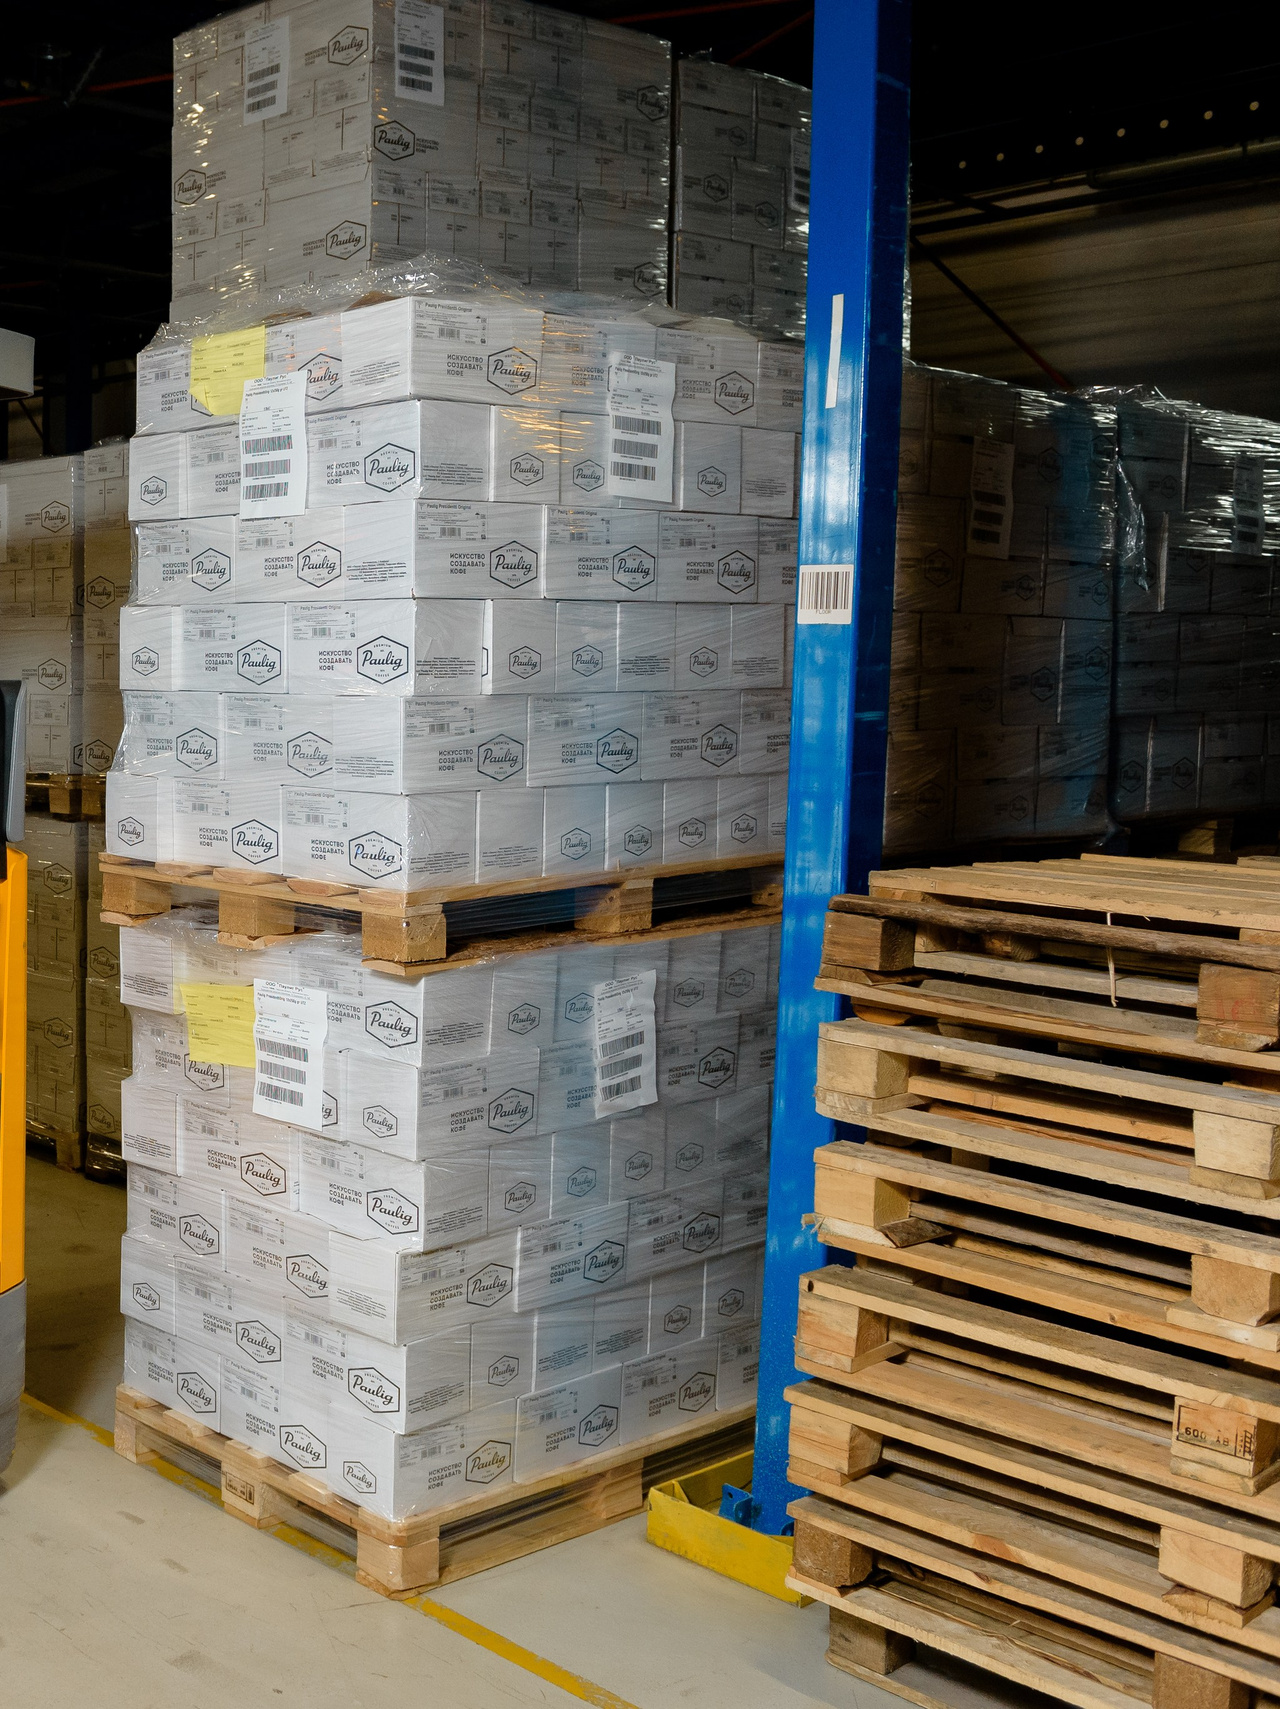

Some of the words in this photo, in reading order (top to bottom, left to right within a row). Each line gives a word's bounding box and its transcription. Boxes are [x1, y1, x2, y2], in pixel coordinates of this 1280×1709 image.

[332, 37, 364, 53] Paulig
[378, 132, 410, 149] Paulig
[177, 181, 203, 194] Paulig
[330, 234, 361, 249] Paulig
[447, 362, 483, 370] СОЗДАВАТЬ
[493, 360, 531, 383] Paulig
[718, 384, 749, 402] Paulig
[369, 459, 409, 477] Paulig
[513, 462, 541, 477] Paulig
[576, 470, 601, 482] Paulig
[700, 474, 724, 488] Paulig
[43, 511, 67, 523] Paulig
[196, 561, 226, 579] Paulig
[301, 556, 336, 574] Paulig
[495, 556, 533, 575] Paulig
[617, 561, 651, 578] Paulig
[722, 565, 751, 581] Paulig
[242, 654, 277, 672] Paulig
[361, 650, 403, 670] Paulig
[512, 657, 538, 670] Paulig
[574, 657, 599, 668] Paulig
[41, 669, 63, 681] Paulig
[180, 740, 213, 760] Paulig
[601, 742, 634, 760] Paulig
[705, 738, 733, 752] Paulig
[88, 749, 110, 762] Paulig
[292, 744, 328, 766] Paulig
[483, 748, 519, 768] Paulig
[236, 833, 273, 852] Paulig
[311, 839, 344, 847] ИСКУССТВО
[311, 847, 344, 855] СОЗДАВАТЬ
[354, 843, 395, 865] Paulig
[328, 1001, 360, 1013] ИСКУССТВО
[328, 1007, 360, 1020] СОЗДАВАТЬ
[370, 1012, 412, 1037] Paulig
[512, 1013, 537, 1025] Paulig
[702, 1061, 732, 1075] Paulig
[451, 1107, 484, 1118] ИСКУССТВО
[493, 1103, 529, 1120] Paulig
[366, 1115, 393, 1131] Paulig
[451, 1114, 484, 1125] СОЗДАВАТЬ
[451, 1125, 466, 1133] КОФЕ
[207, 1149, 236, 1162] ИСКУССТВО
[207, 1155, 236, 1168] СОЗДАВАТЬ
[207, 1162, 222, 1170] КОФЕ
[245, 1165, 281, 1186] Paulig
[329, 1183, 362, 1198] ИСКУССТВО
[329, 1190, 362, 1205] СОЗДАВАТЬ
[508, 1191, 532, 1205] Paulig
[329, 1198, 345, 1206] КОФЕ
[372, 1198, 413, 1225] Paulig
[183, 1224, 215, 1247] Paulig
[253, 1246, 282, 1262] ИСКУССТВО
[253, 1254, 282, 1269] СОЗДАВАТЬ
[589, 1252, 619, 1269] Paulig
[253, 1261, 267, 1269] КОФЕ
[290, 1264, 328, 1289] Paulig
[430, 1283, 463, 1297] ИСКУССТВО
[471, 1275, 508, 1294] Paulig
[430, 1291, 463, 1304] СОЗДАВАТЬ
[430, 1302, 445, 1311] КОФЕ
[240, 1328, 276, 1354] Paulig
[312, 1356, 343, 1374] ИСКУССТВО
[312, 1363, 343, 1381] СОЗДАВАТЬ
[491, 1365, 515, 1376] Paulig
[312, 1371, 327, 1380] КОФЕ
[181, 1379, 212, 1406] Paulig
[353, 1375, 393, 1405] Paulig
[683, 1383, 711, 1399] Paulig
[246, 1412, 275, 1431] ИСКУССТВО
[246, 1420, 275, 1437] СОЗДАВАТЬ
[583, 1417, 614, 1434] Paulig
[246, 1428, 261, 1436] КОФЕ
[1184, 1426, 1207, 1440] 600
[284, 1432, 321, 1461] Paulig
[429, 1462, 462, 1476] ИСКУССТВО
[471, 1453, 506, 1472] Paulig
[347, 1467, 373, 1487] Paulig
[429, 1469, 462, 1482] СОЗДАВАТЬ
[428, 1481, 444, 1490] КОФЕ
